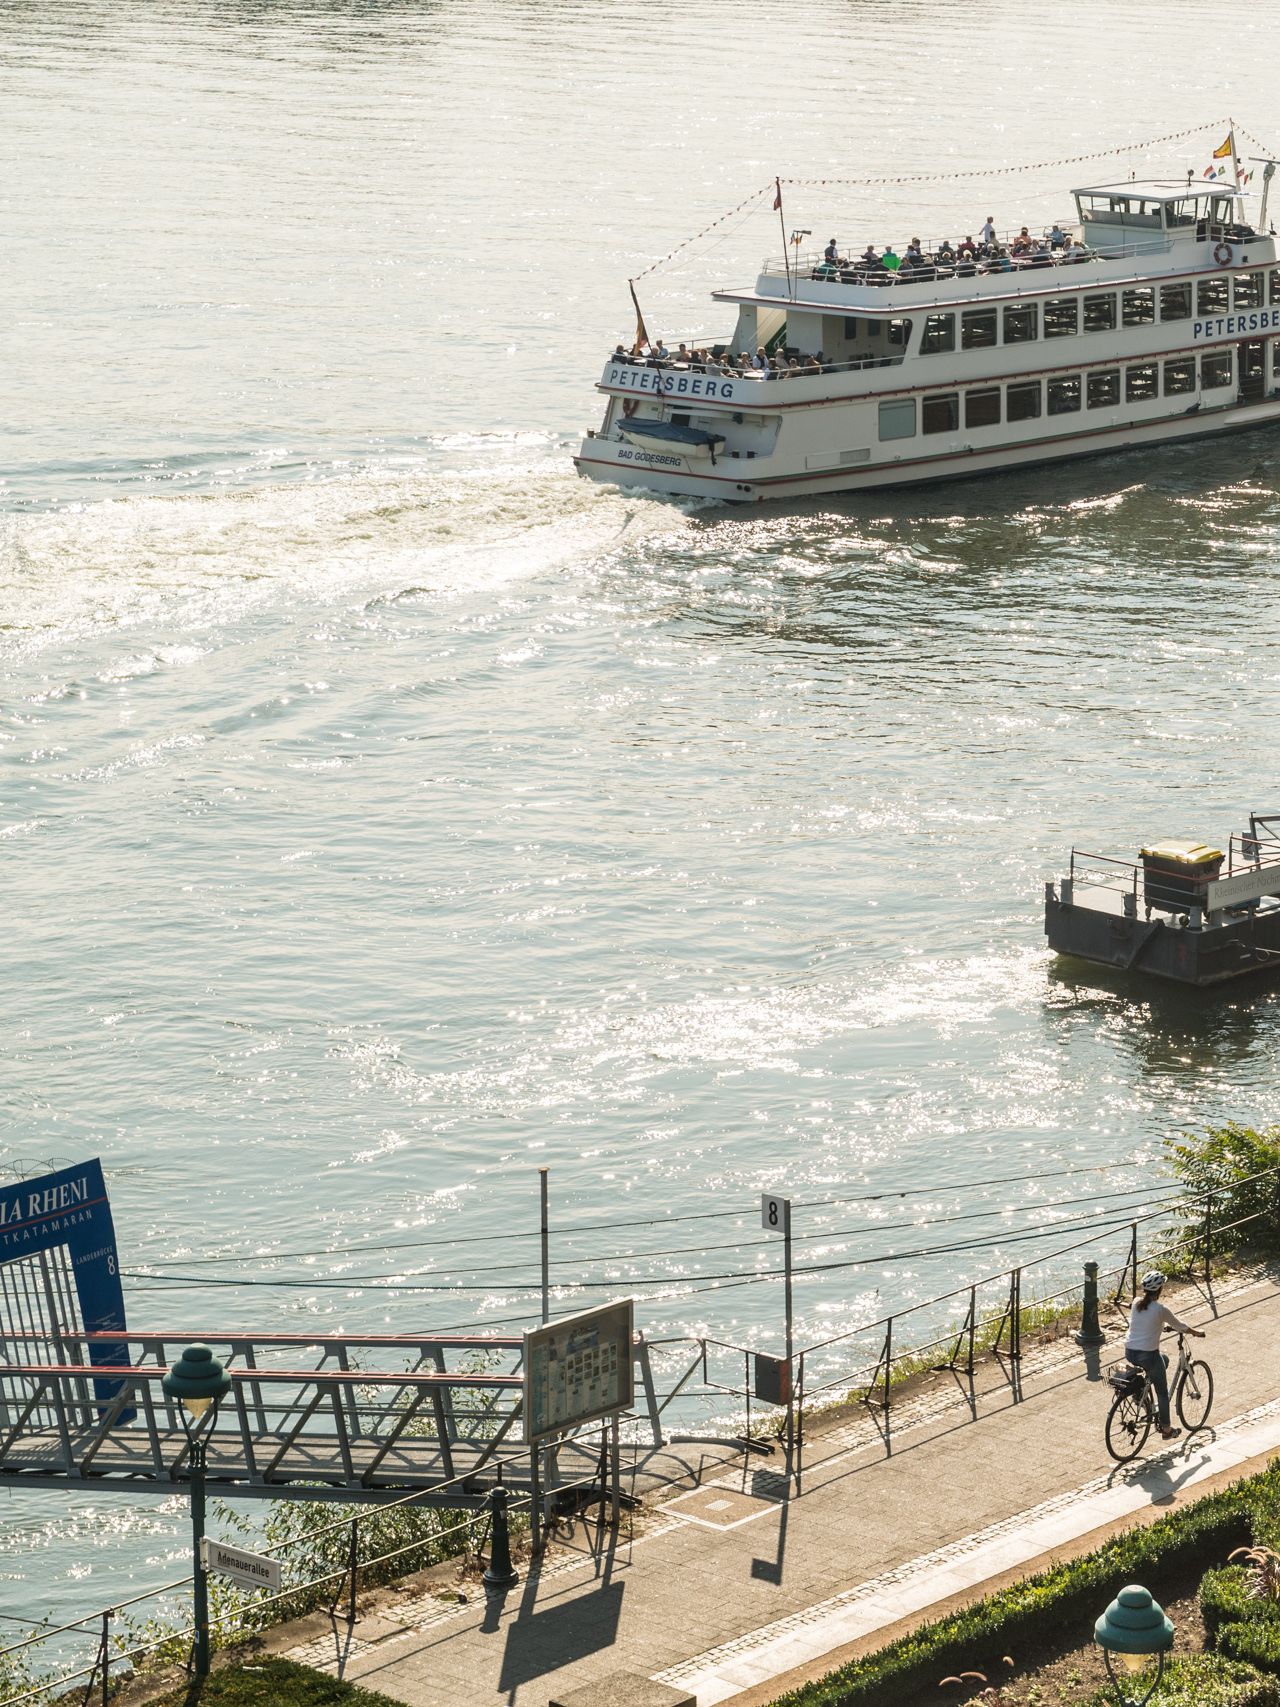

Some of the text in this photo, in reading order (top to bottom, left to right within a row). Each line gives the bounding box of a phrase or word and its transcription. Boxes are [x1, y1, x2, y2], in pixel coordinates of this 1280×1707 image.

[609, 369, 734, 398] PETERSBERG
[617, 449, 682, 467] BAD GODESBERG
[28, 1177, 88, 1217] RHENI
[3, 1209, 92, 1245] TKATAMARAN
[768, 1201, 778, 1226] 8
[107, 1255, 116, 1276] 8
[217, 1551, 270, 1578] Adenauerallee
